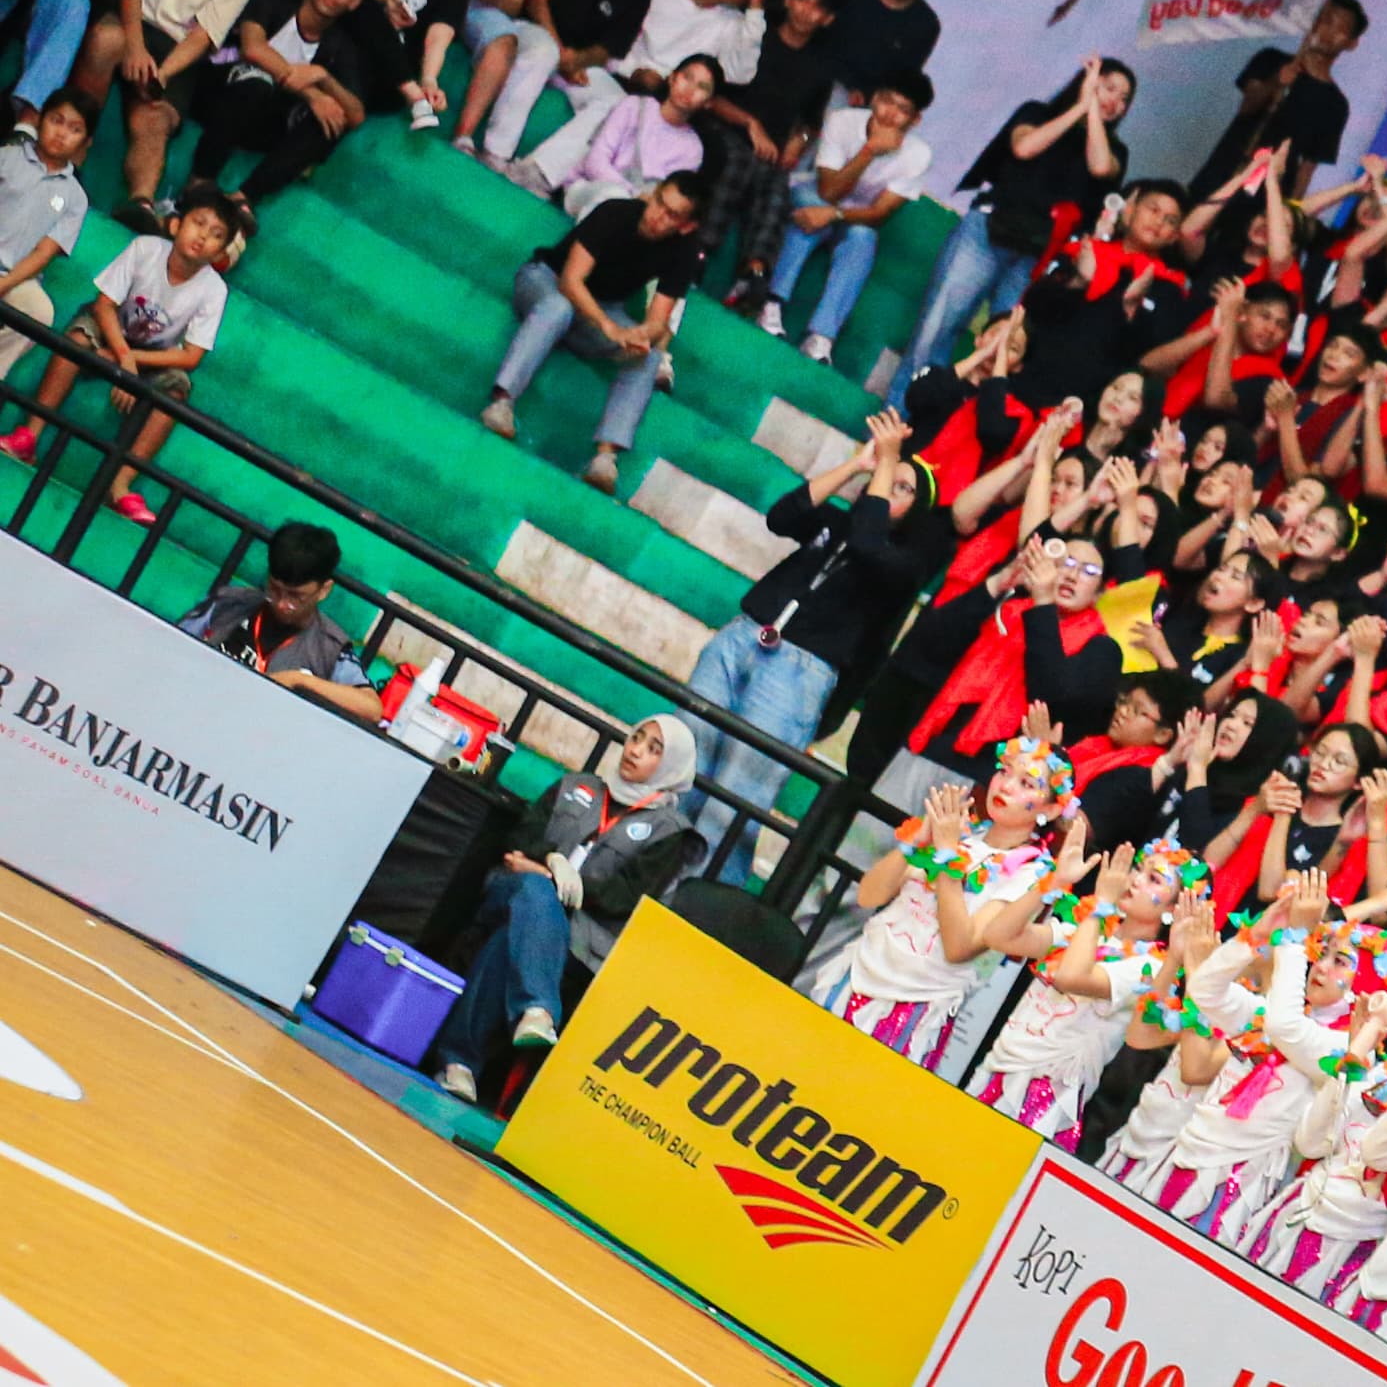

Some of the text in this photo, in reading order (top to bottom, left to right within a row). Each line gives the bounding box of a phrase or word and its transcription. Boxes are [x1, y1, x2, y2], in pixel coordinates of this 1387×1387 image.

[13, 676, 293, 853] BANJARMASIN
[579, 1075, 702, 1170] THE CHAMPION BALL
[593, 1006, 948, 1245] proteam
